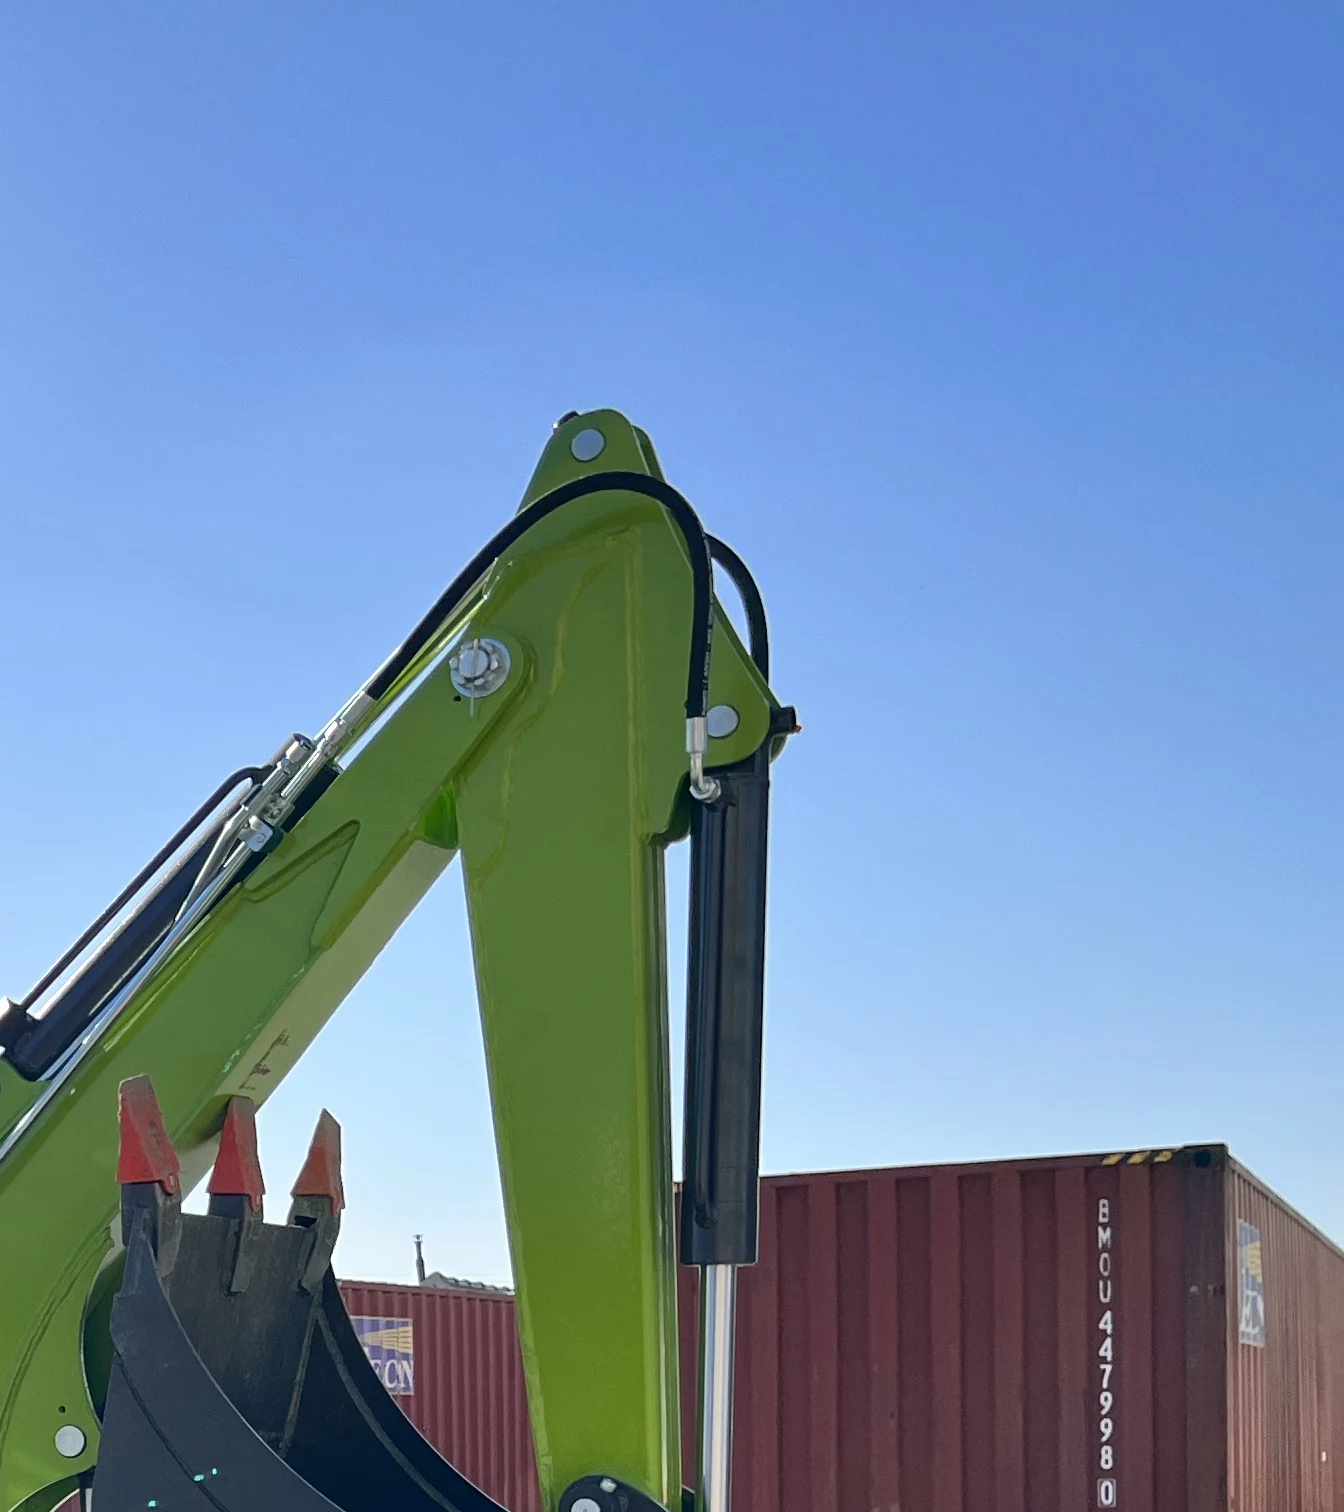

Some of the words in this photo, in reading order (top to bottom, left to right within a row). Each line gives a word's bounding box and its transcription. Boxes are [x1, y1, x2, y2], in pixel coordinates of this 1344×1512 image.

[1097, 1198, 1112, 1303] BMOU
[1098, 1309, 1113, 1470] 447998
[1100, 1479, 1114, 1503] 0
